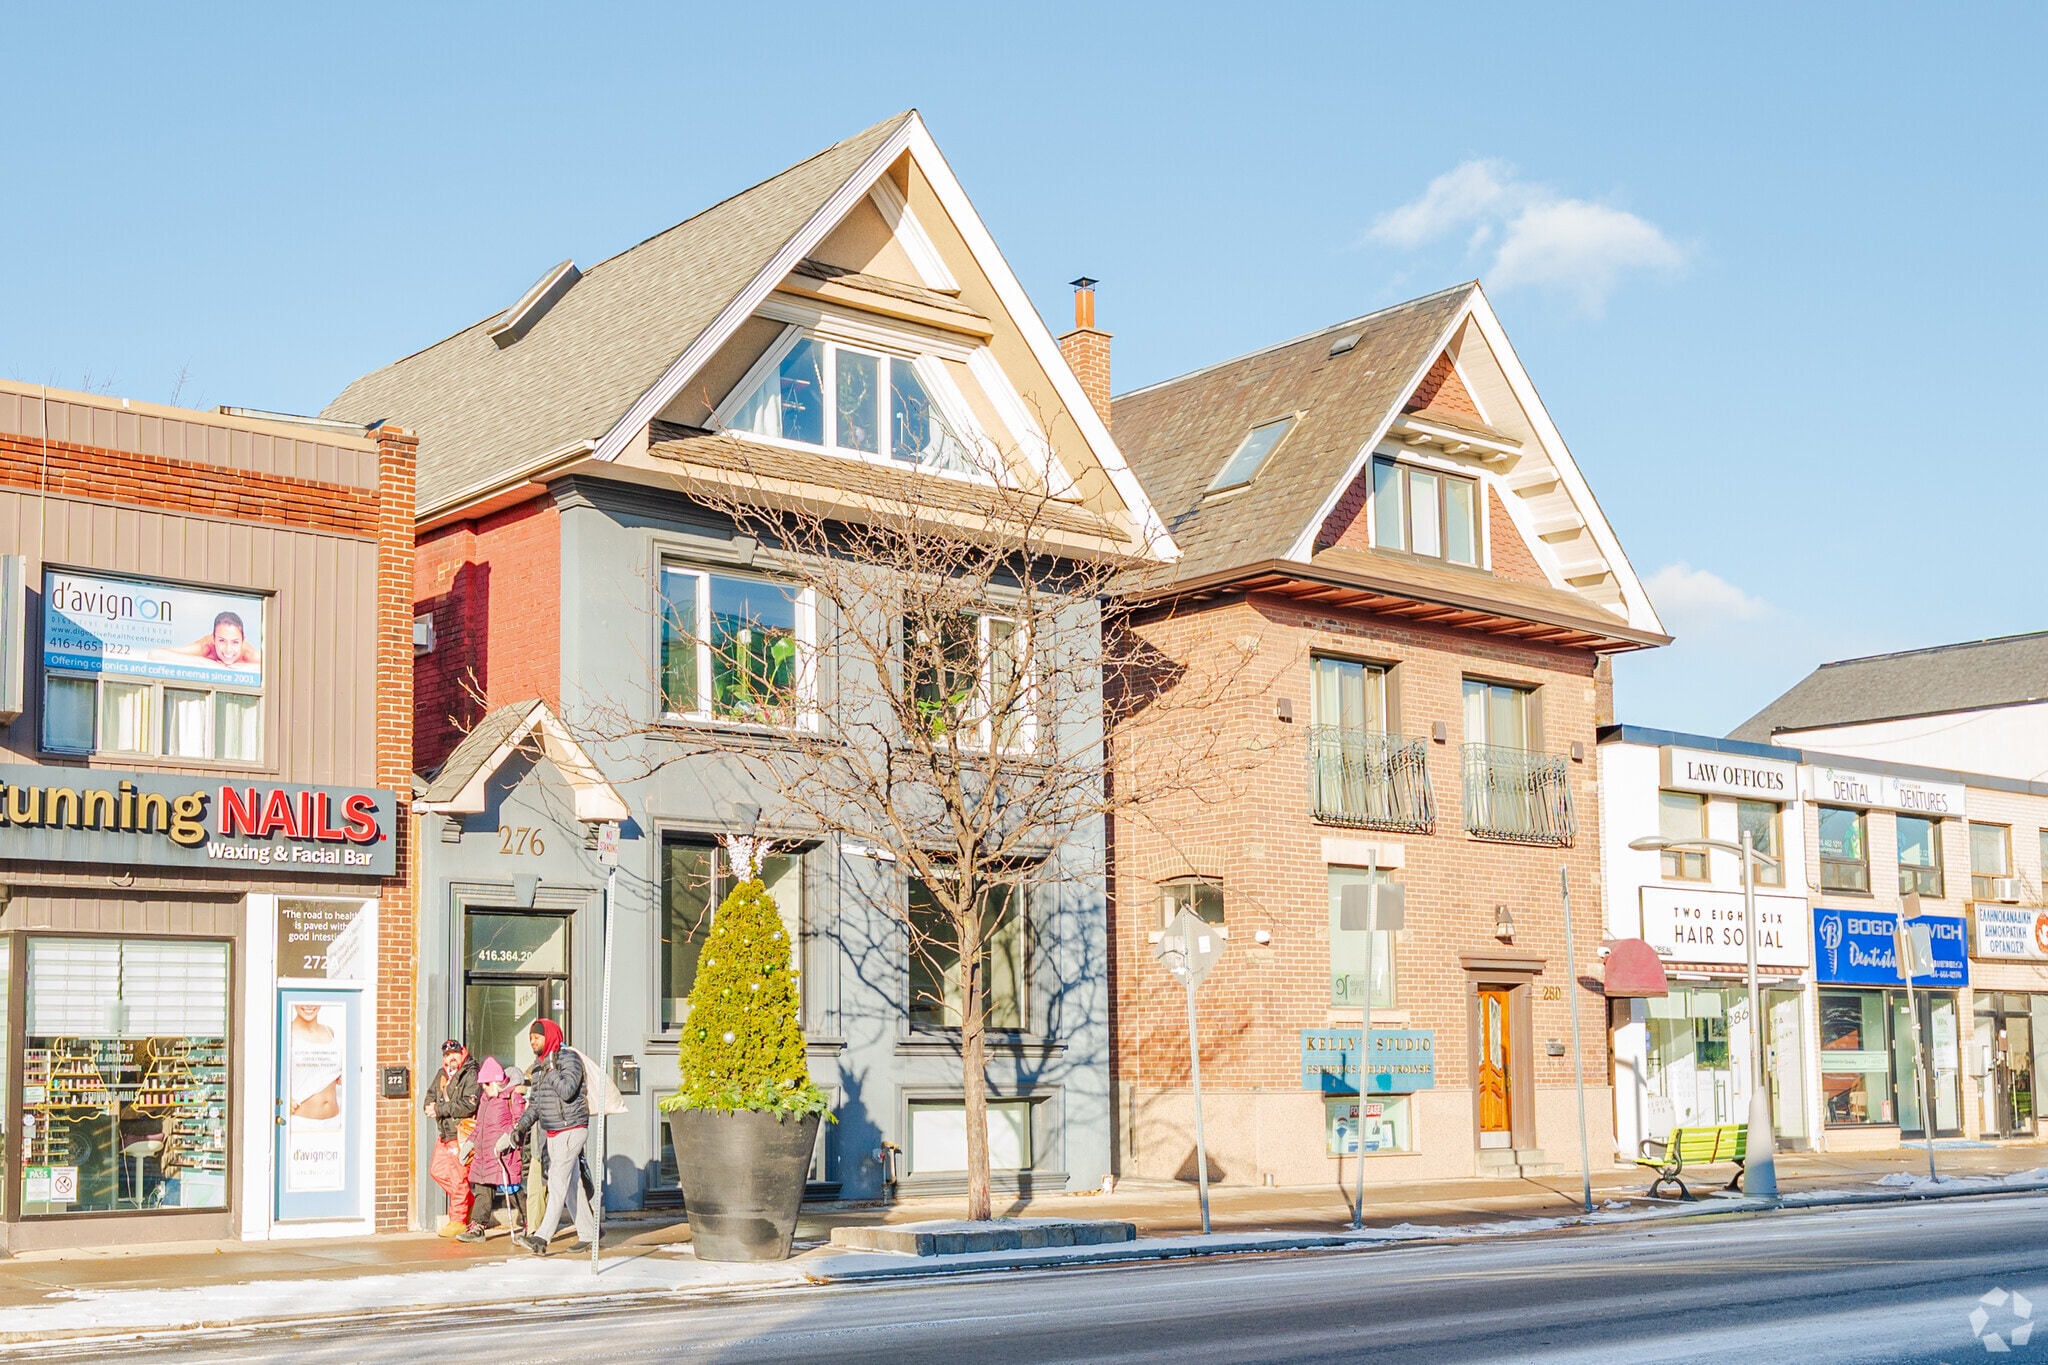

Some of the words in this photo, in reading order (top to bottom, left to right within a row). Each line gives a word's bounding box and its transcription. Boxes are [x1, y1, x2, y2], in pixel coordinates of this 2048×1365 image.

[52, 582, 172, 621] d'avignon
[50, 637, 131, 655] 416-465-1222
[51, 655, 89, 669] Offering
[91, 659, 128, 673] colonics
[131, 664, 146, 674] and
[148, 665, 175, 677] coffee
[176, 669, 210, 680] enemas
[211, 671, 232, 681] since
[1687, 761, 1719, 783] LAW
[1723, 766, 1784, 790] OFFICES
[1833, 781, 1873, 804] DENTAL
[1900, 789, 1949, 813] DENTURES
[0, 780, 206, 844] unning
[218, 785, 377, 842] NAILS
[497, 824, 545, 857] 276
[206, 841, 271, 865] Waxing
[273, 845, 288, 862] &
[292, 846, 340, 865] Facial
[344, 849, 373, 866] Bar
[303, 910, 322, 920] road
[324, 911, 334, 920] to
[1674, 907, 1701, 919] TWO
[1712, 909, 1743, 921] EIGH
[1761, 913, 1783, 924] SIX
[294, 920, 302, 930] is
[303, 921, 329, 932] paved
[288, 932, 310, 943] good
[1674, 924, 1715, 945] HAIR
[1723, 927, 1783, 949] SOIAL
[1306, 1036, 1370, 1051] KELLY'
[1376, 1037, 1431, 1051] STUDIO
[1306, 1064, 1357, 1075] ESTHETICS
[1368, 1064, 1432, 1075] ELECTROLYSIS
[388, 1076, 403, 1085] 272
[1350, 1106, 1359, 1115] FO
[1367, 1104, 1381, 1113] EASE
[29, 1170, 49, 1180] PASS
